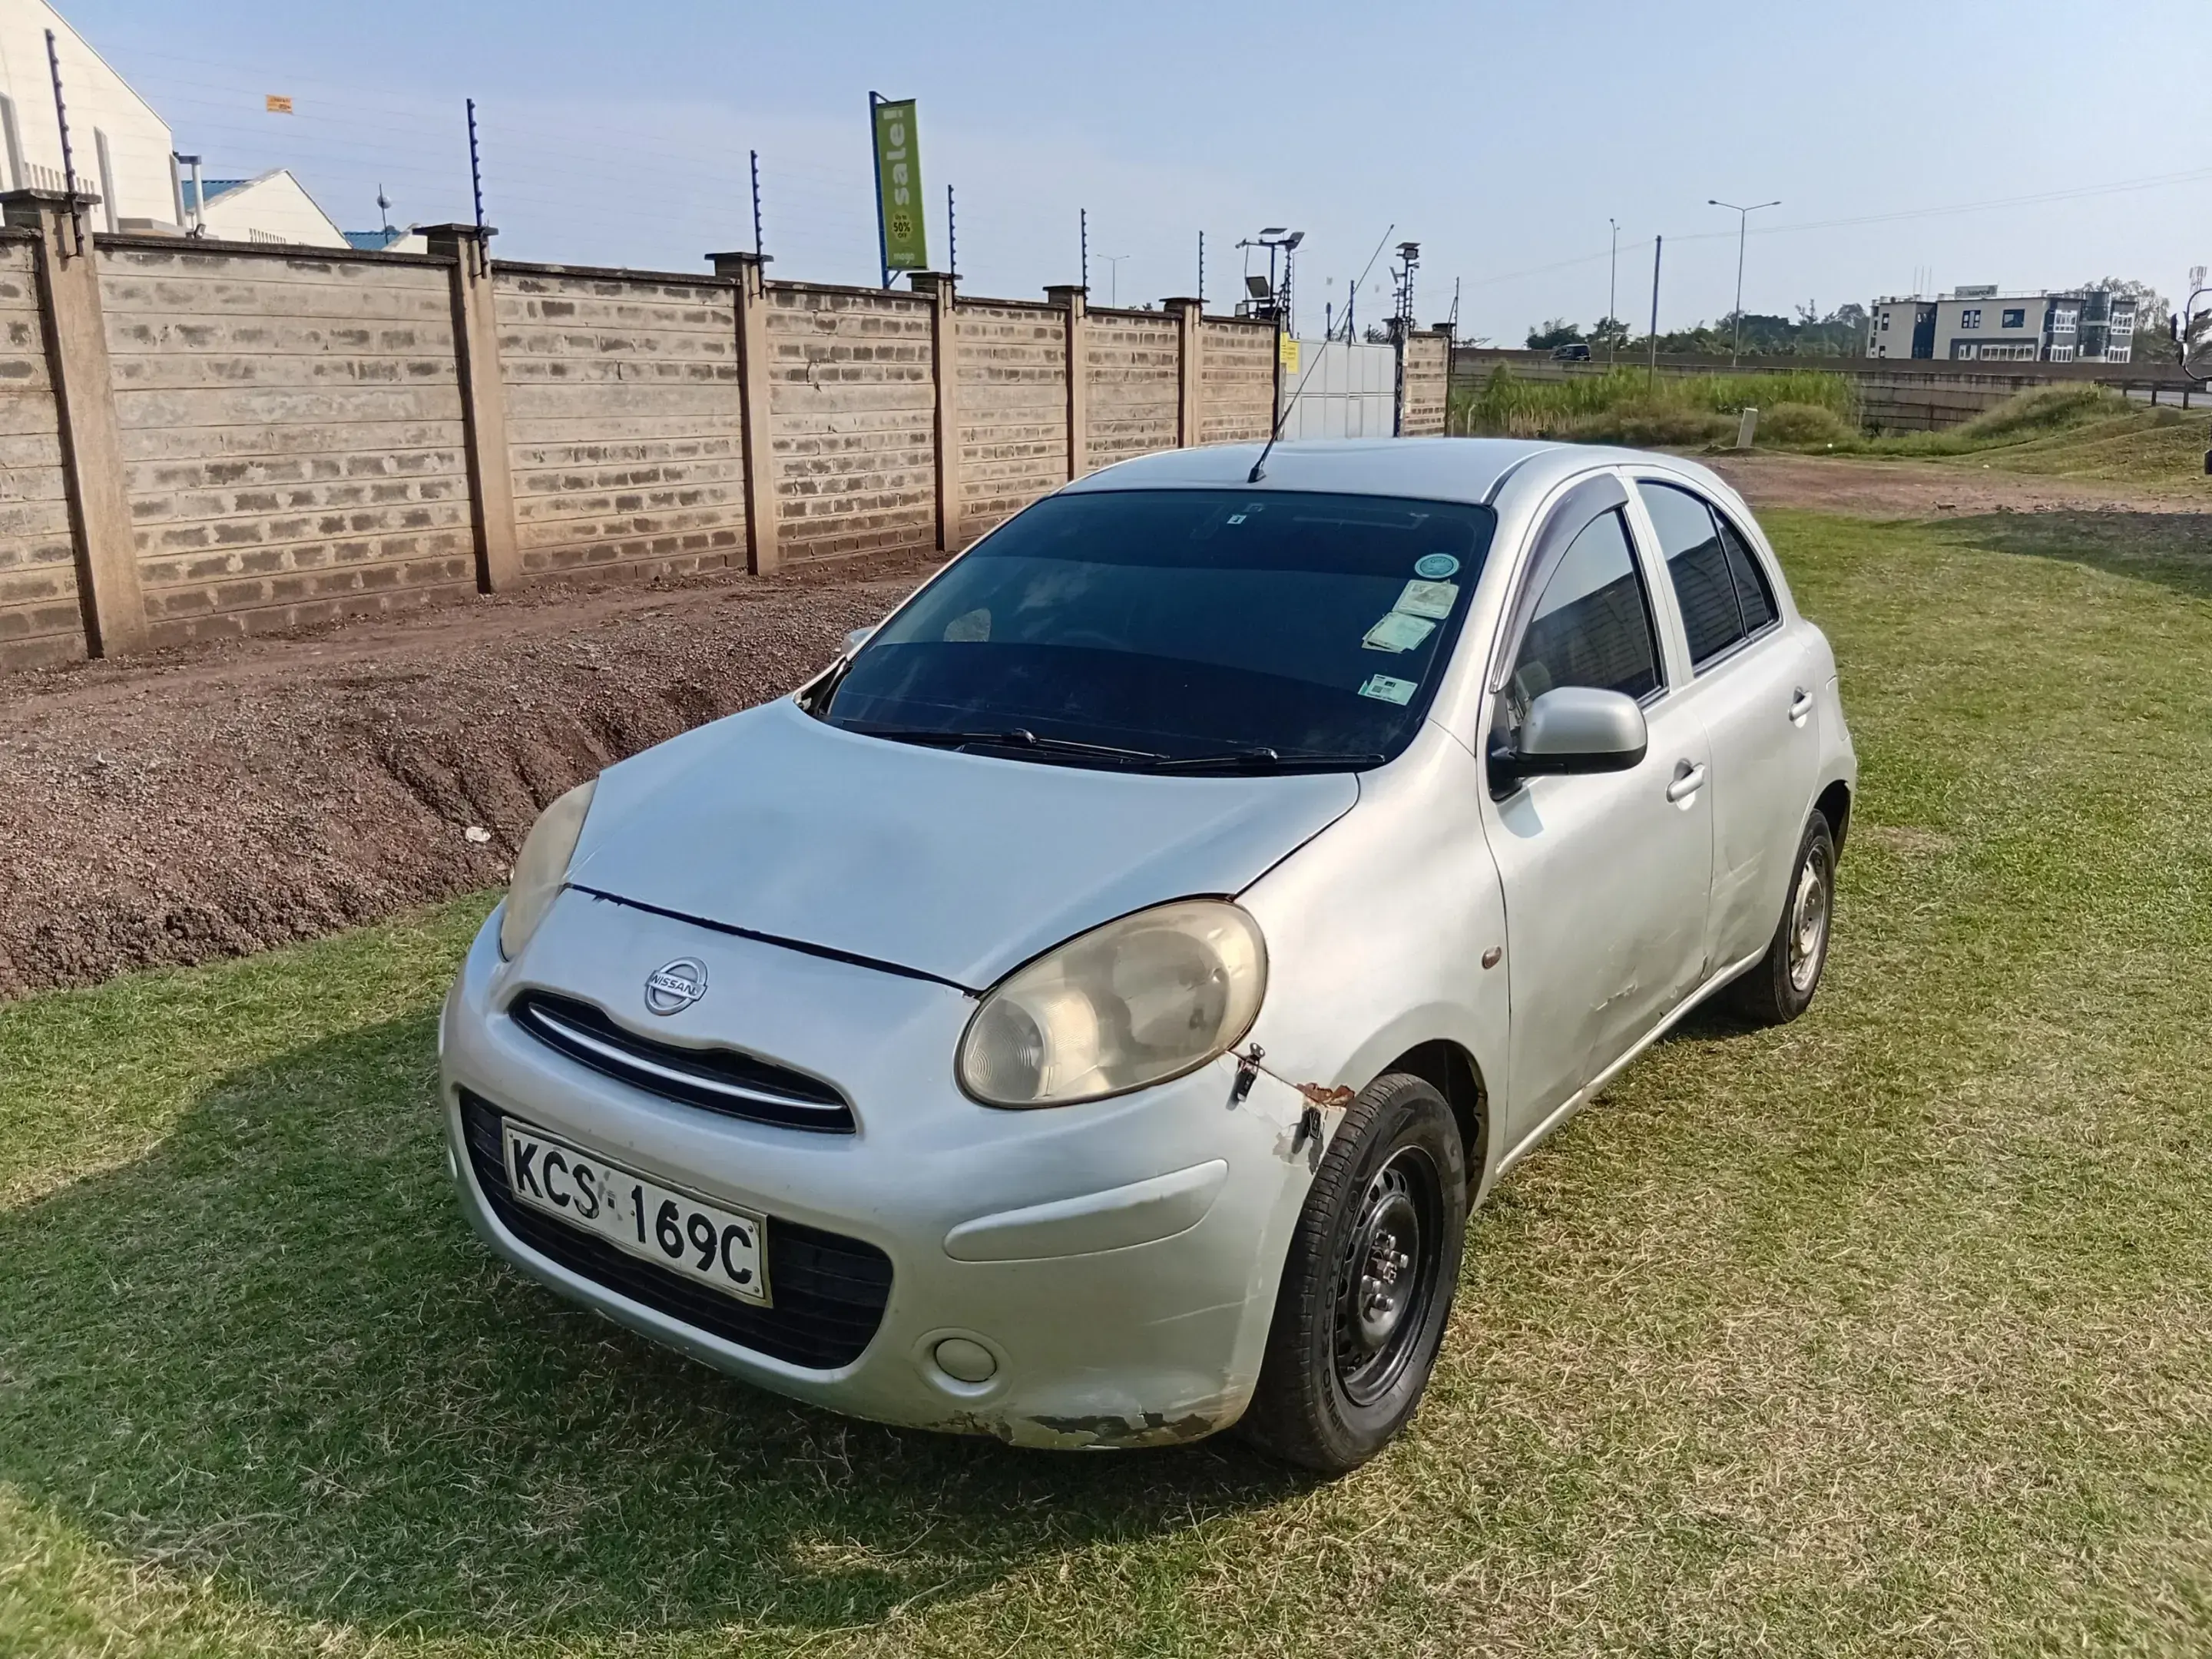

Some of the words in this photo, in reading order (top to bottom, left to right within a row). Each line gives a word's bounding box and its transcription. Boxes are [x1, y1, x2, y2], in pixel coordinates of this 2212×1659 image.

[893, 222, 911, 232] 50%
[651, 975, 696, 995] NISSAN
[513, 1139, 600, 1220] KCS
[631, 1185, 753, 1284] 169C
